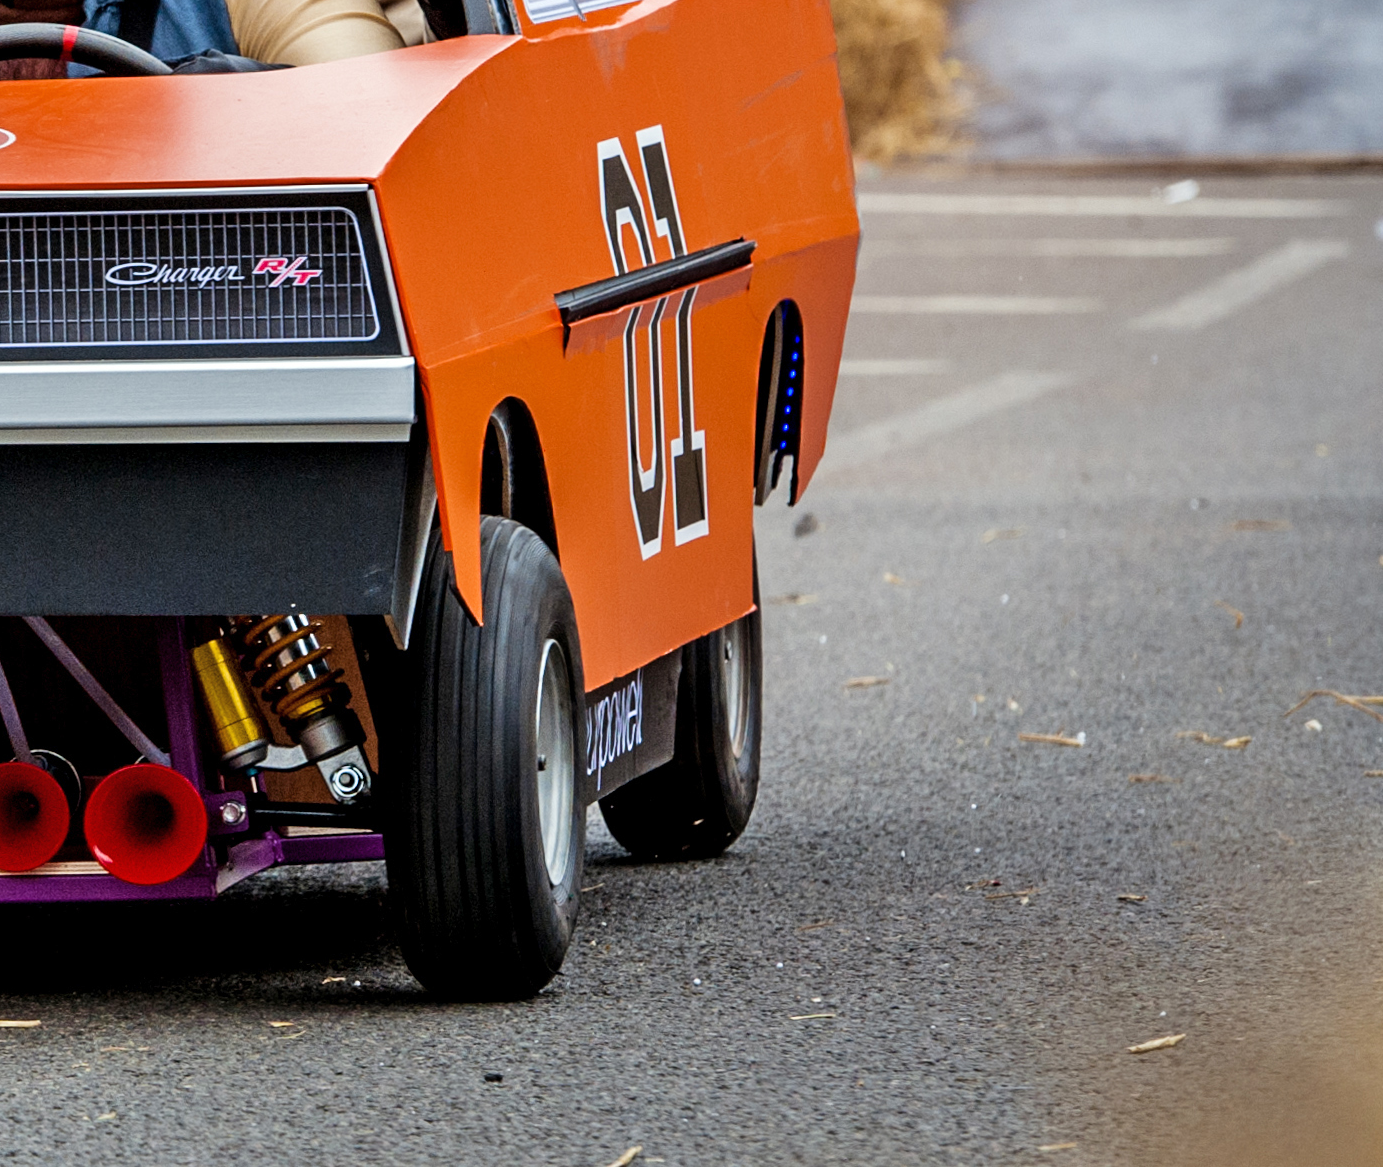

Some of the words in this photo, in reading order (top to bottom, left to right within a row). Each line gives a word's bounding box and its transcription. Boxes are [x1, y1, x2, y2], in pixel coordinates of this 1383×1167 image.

[105, 262, 245, 288] Charger
[252, 256, 323, 287] R/T
[597, 124, 709, 561] 01
